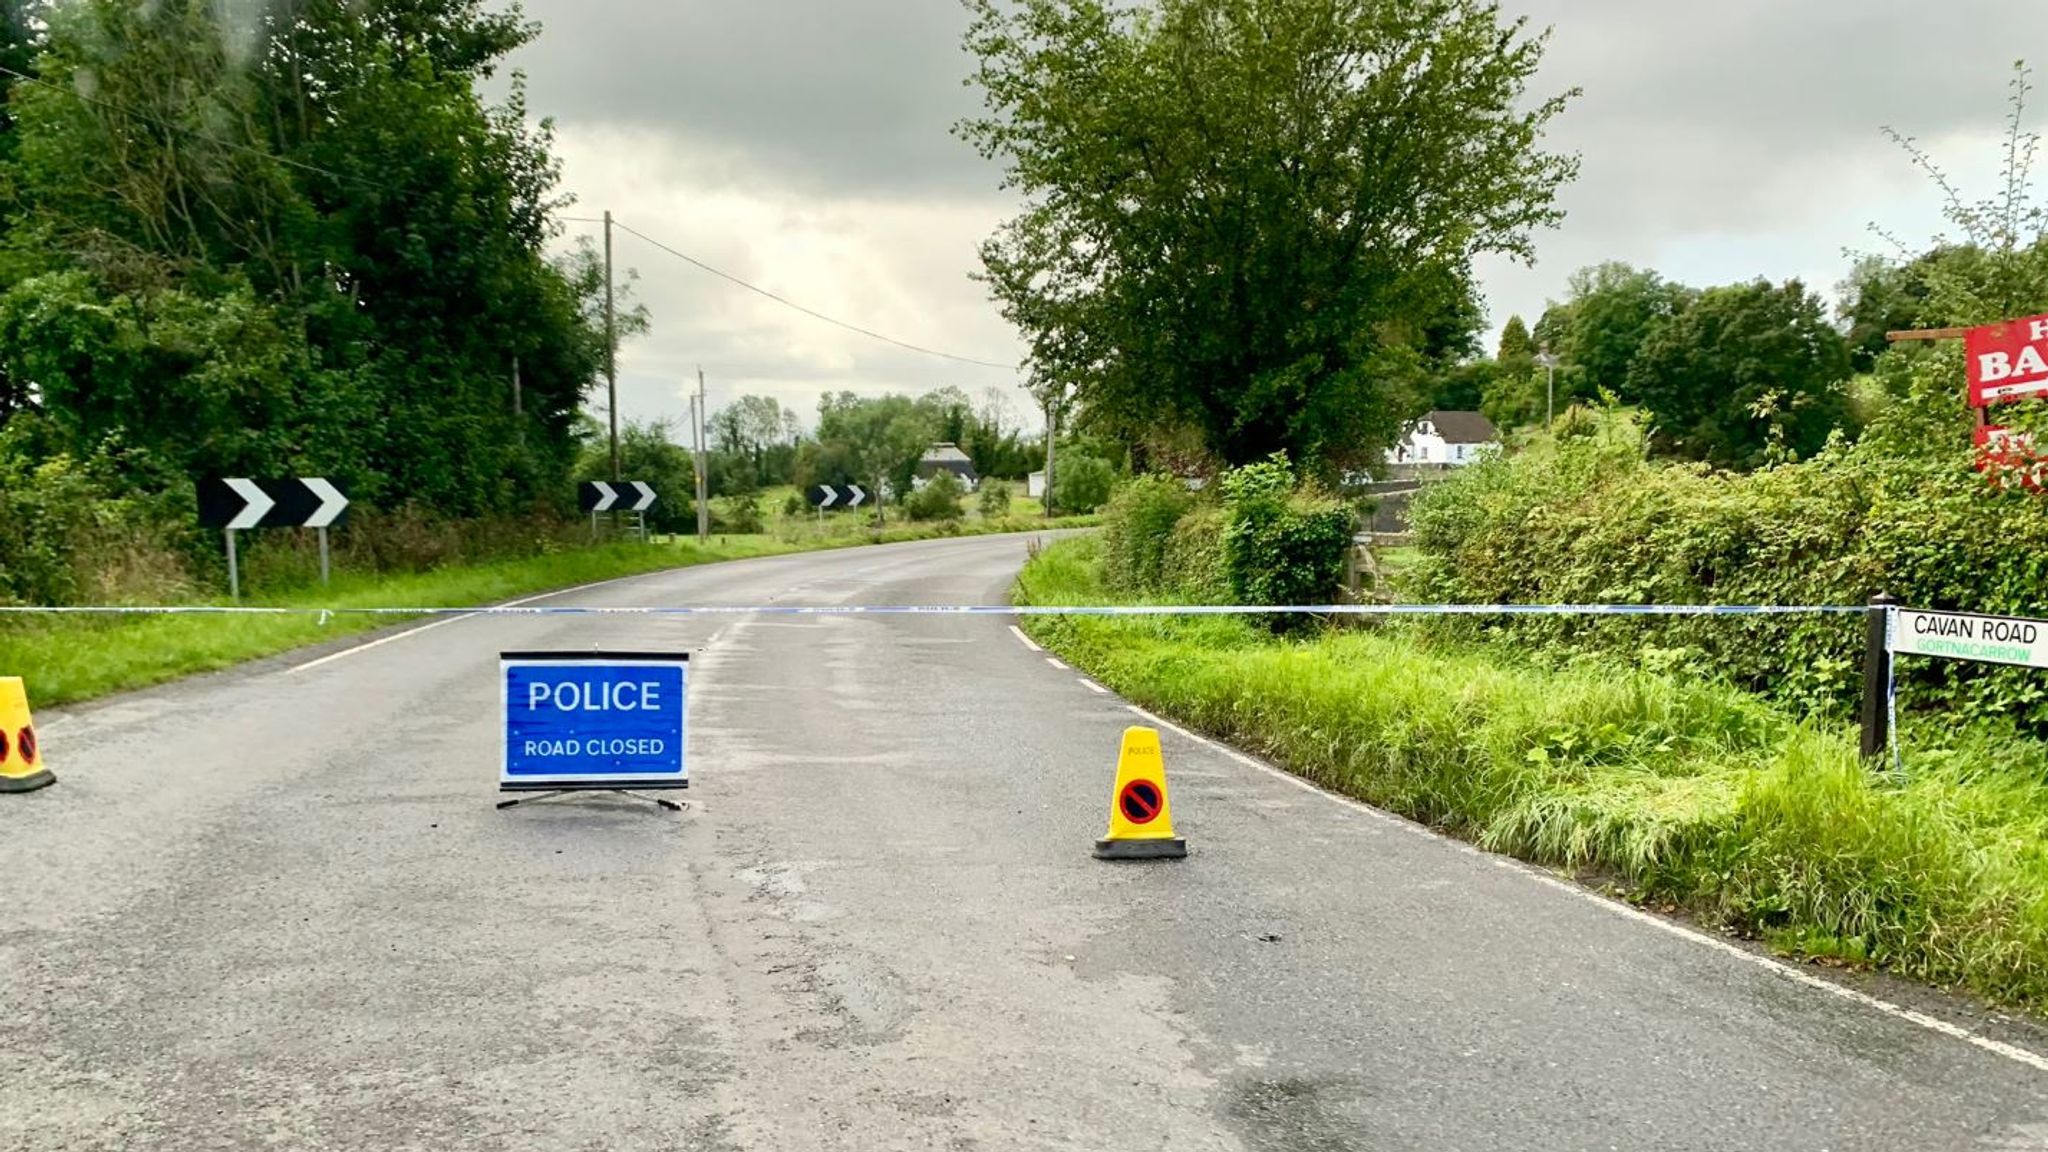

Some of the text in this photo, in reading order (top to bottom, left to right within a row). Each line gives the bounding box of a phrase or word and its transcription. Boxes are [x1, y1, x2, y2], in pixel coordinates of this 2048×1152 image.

[1914, 615, 1974, 638] CAVAN
[1982, 621, 2037, 644] ROAD
[1917, 638, 2031, 661] GORTNACARROW
[529, 681, 661, 711] POLICE
[525, 739, 664, 756] ROAD CLOSED
[1128, 746, 1155, 756] POLICE
